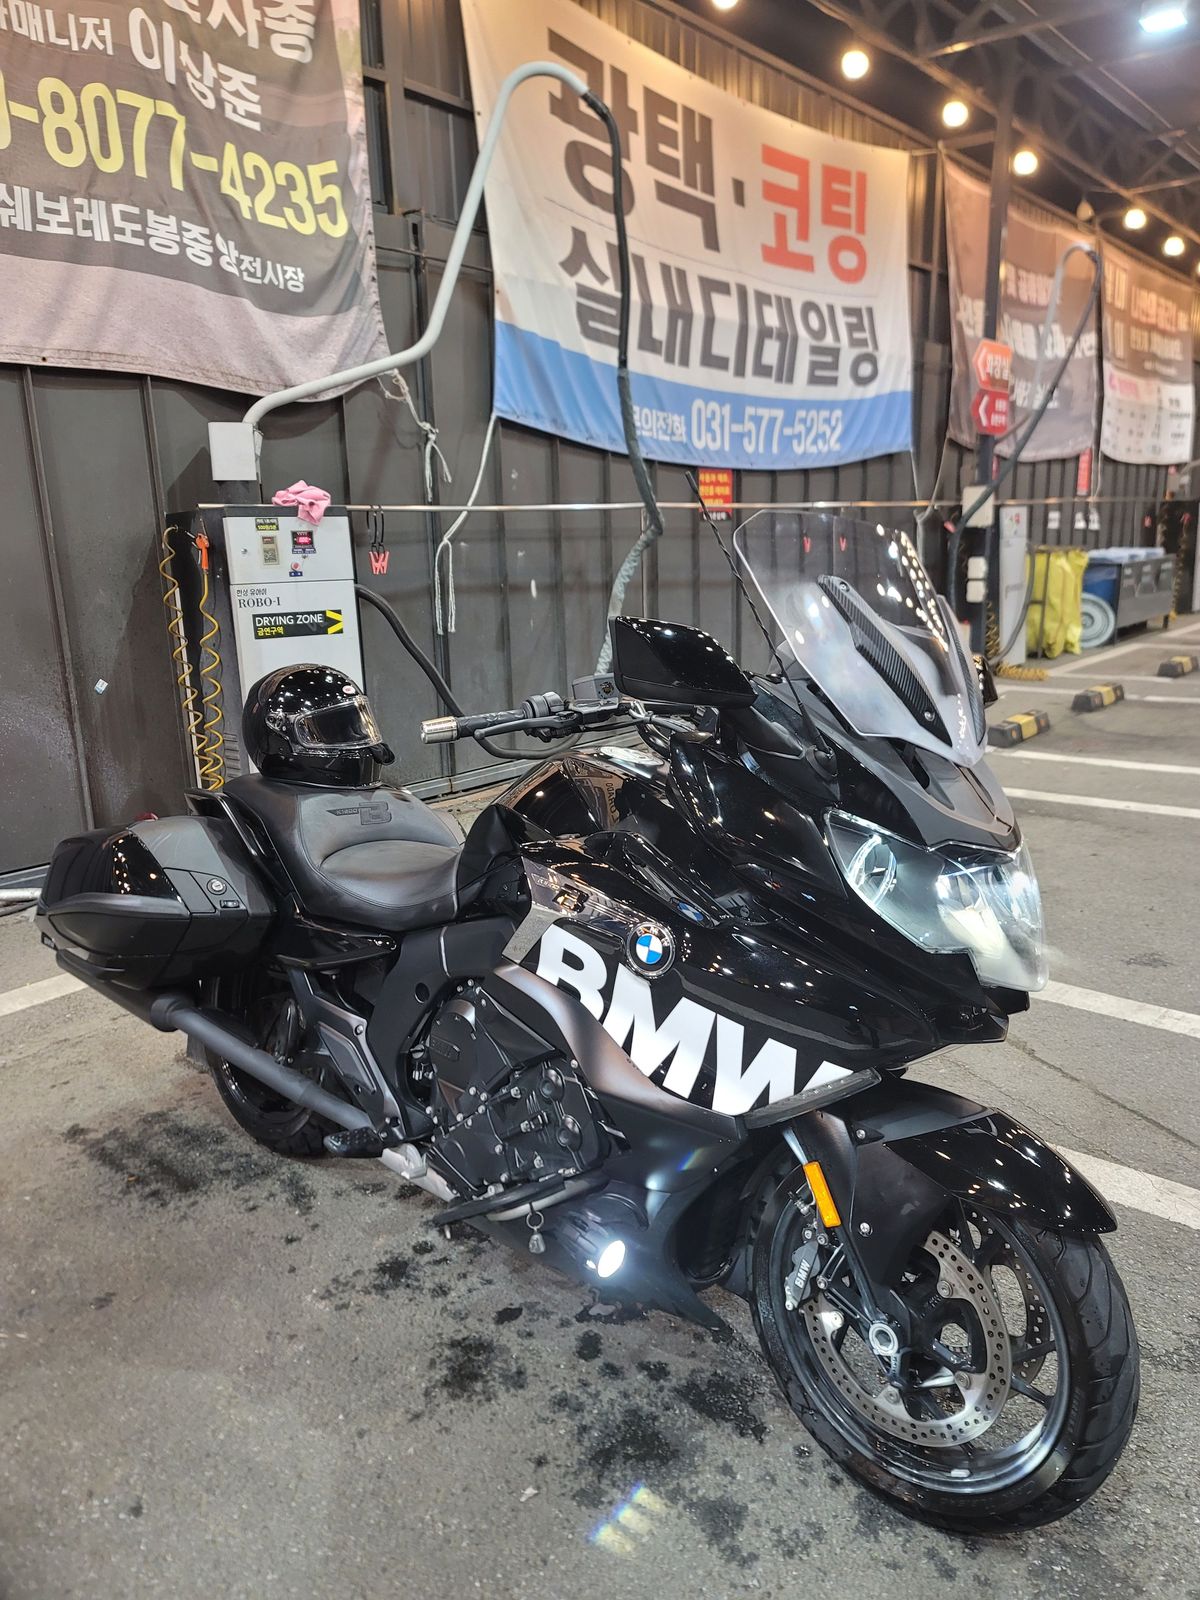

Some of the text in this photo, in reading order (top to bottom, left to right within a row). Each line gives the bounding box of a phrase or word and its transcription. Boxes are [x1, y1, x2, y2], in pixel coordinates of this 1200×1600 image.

[128, 7, 262, 132] 이상준
[691, 398, 843, 455] 031-577-5252
[255, 613, 324, 627] DRYING ZONE
[536, 923, 854, 1116] BMW
[795, 1258, 811, 1289] BMW
